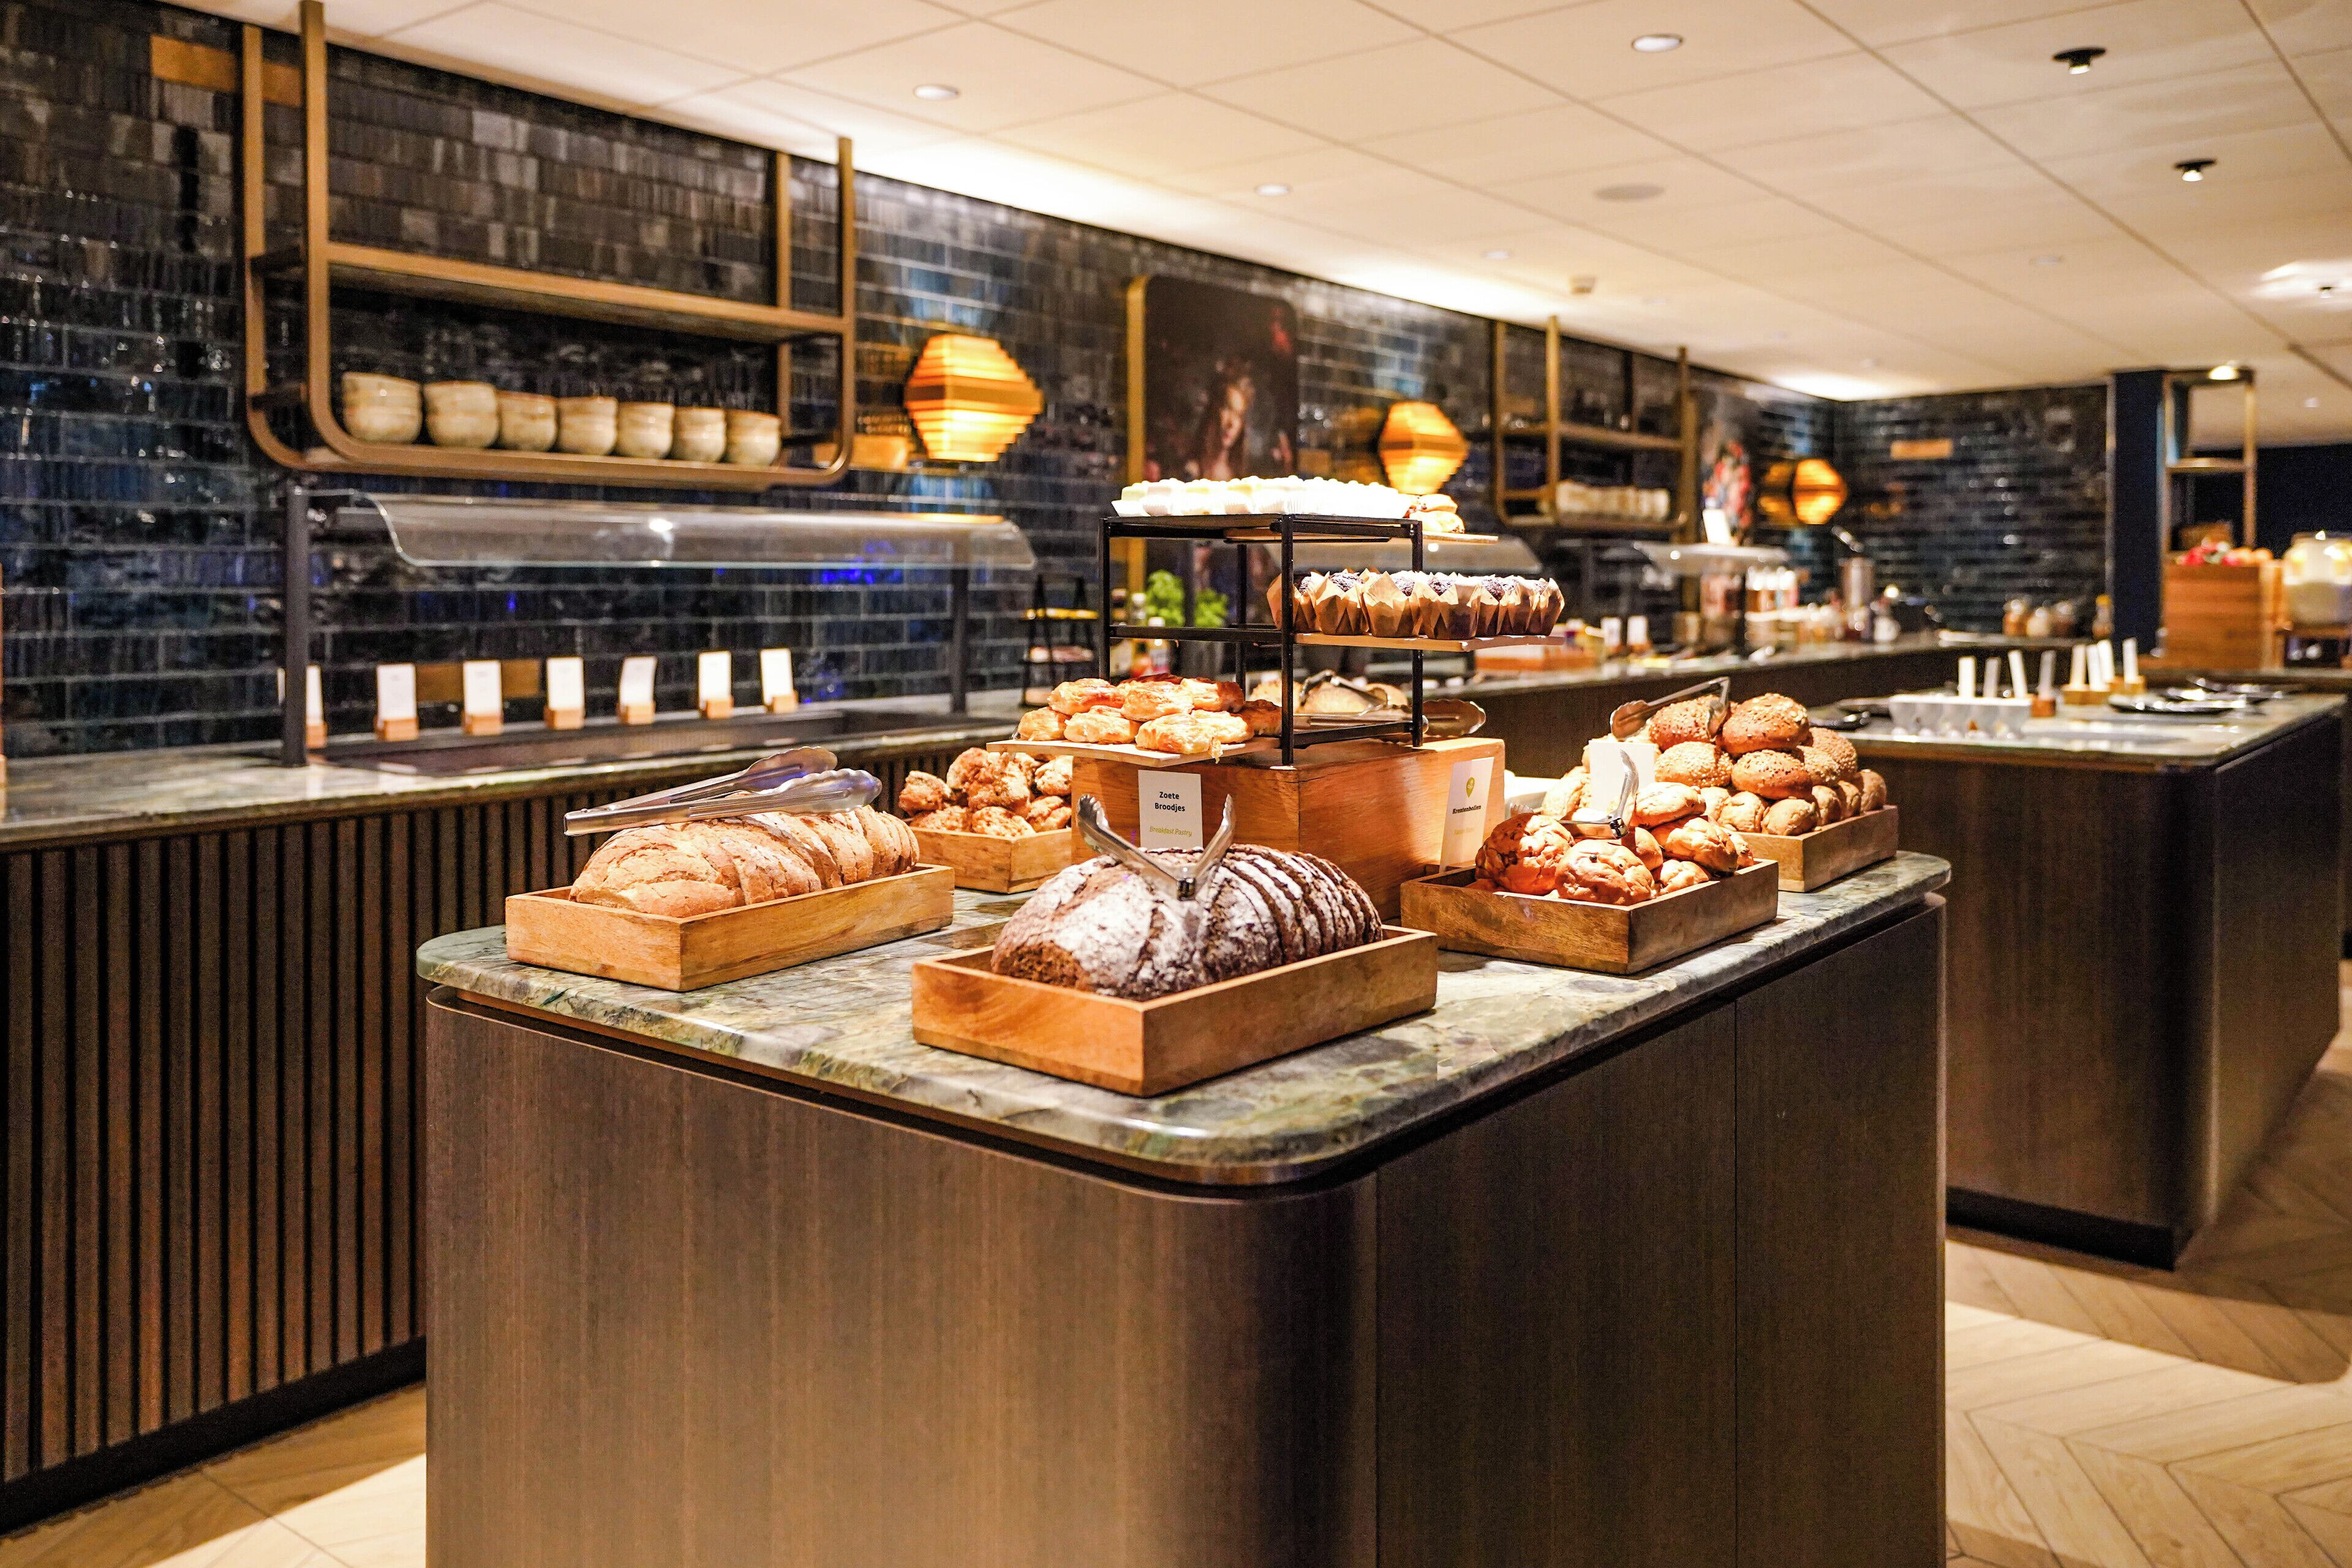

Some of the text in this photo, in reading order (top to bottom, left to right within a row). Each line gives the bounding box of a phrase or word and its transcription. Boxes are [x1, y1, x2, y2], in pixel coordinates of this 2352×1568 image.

[1159, 791, 1180, 799] Zoete
[1155, 802, 1185, 812] Broodjes
[1452, 805, 1481, 814] Krentenbollen
[1150, 826, 1174, 834] Breakfast
